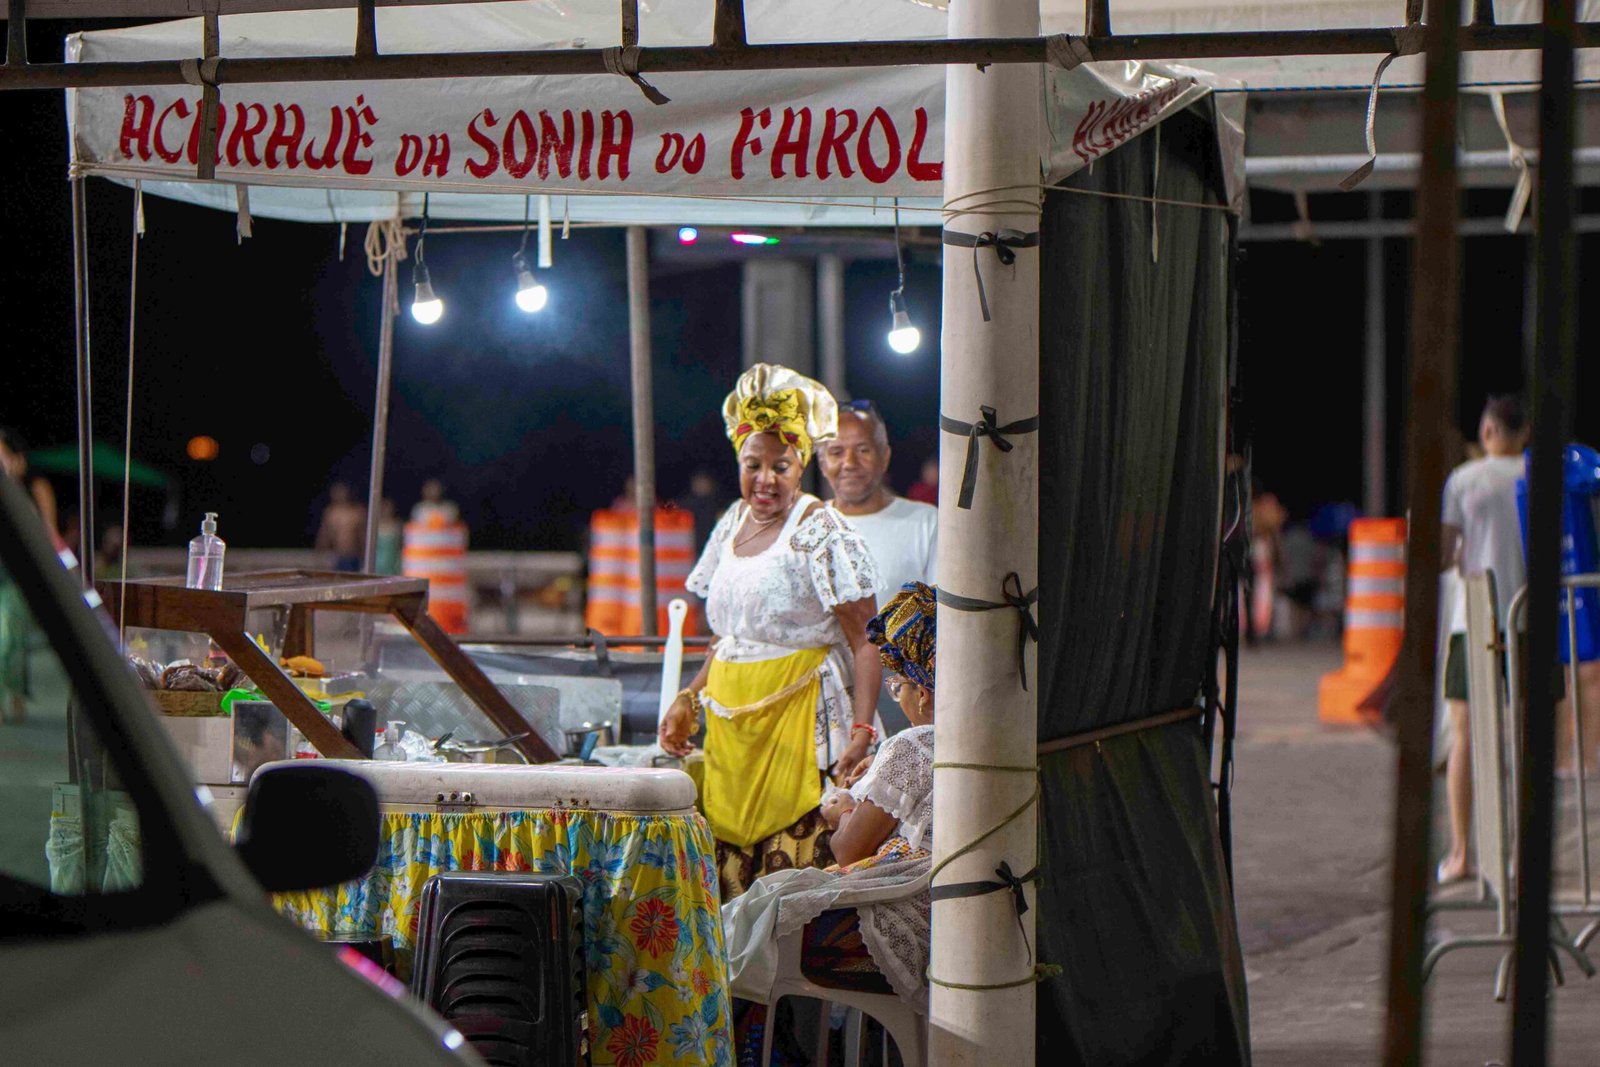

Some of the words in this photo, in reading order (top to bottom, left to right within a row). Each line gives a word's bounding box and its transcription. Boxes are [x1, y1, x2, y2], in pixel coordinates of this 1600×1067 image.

[395, 131, 451, 178] DA
[464, 107, 634, 181] SONIA
[654, 132, 706, 174] DO
[730, 106, 944, 184] FAROL
